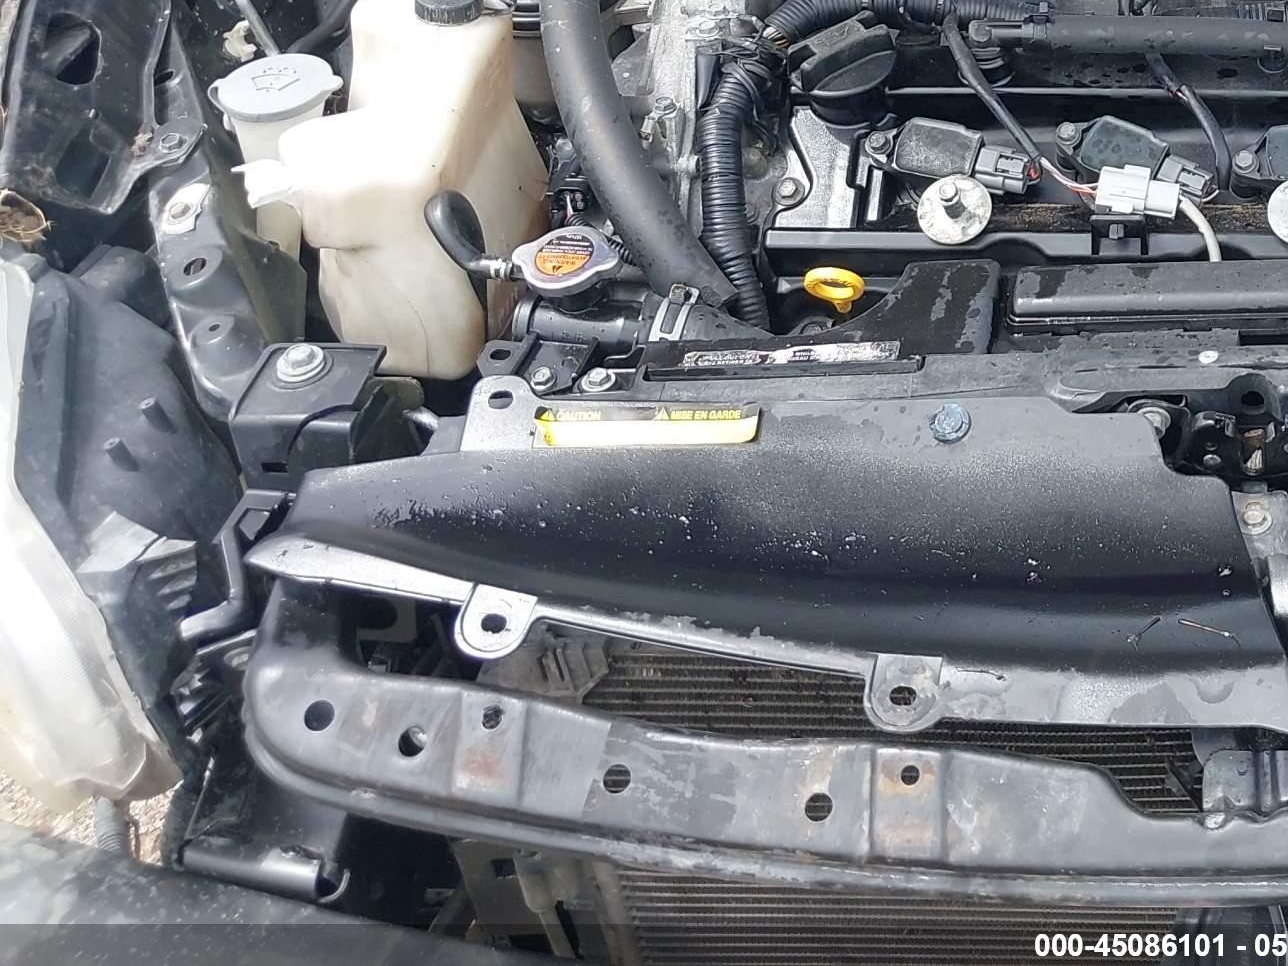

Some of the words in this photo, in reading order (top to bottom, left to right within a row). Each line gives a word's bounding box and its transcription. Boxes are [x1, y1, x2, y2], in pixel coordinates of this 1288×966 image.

[556, 410, 602, 421] CAUTION
[670, 410, 694, 420] MISE
[694, 410, 708, 420] EN
[708, 409, 742, 420] GARDE
